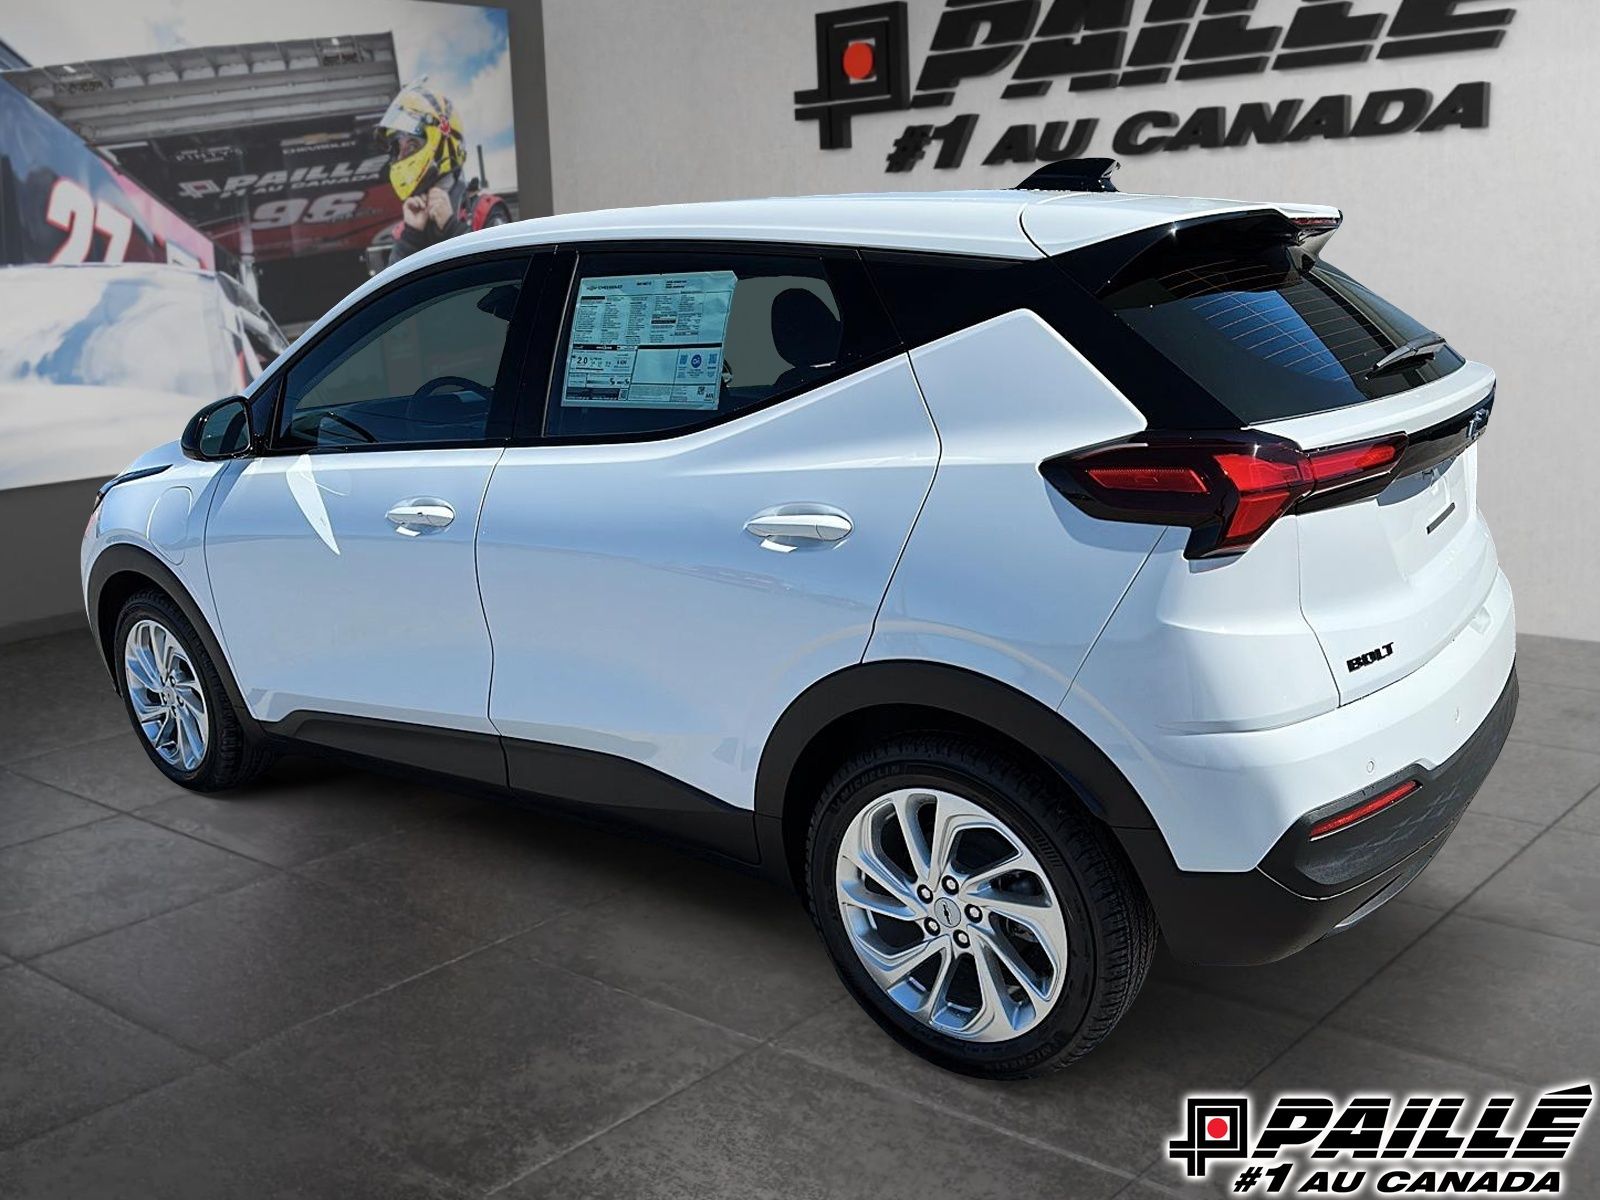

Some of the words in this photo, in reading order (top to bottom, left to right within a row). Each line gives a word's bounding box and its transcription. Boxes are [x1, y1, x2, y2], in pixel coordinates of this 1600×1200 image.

[885, 114, 980, 173] #1
[982, 118, 1099, 166] AU
[1111, 81, 1492, 157] CANADA
[252, 184, 284, 195] AU
[291, 173, 380, 190] CANADA
[46, 177, 134, 264] 27
[251, 191, 366, 230] 96
[1346, 641, 1394, 673] BOLT
